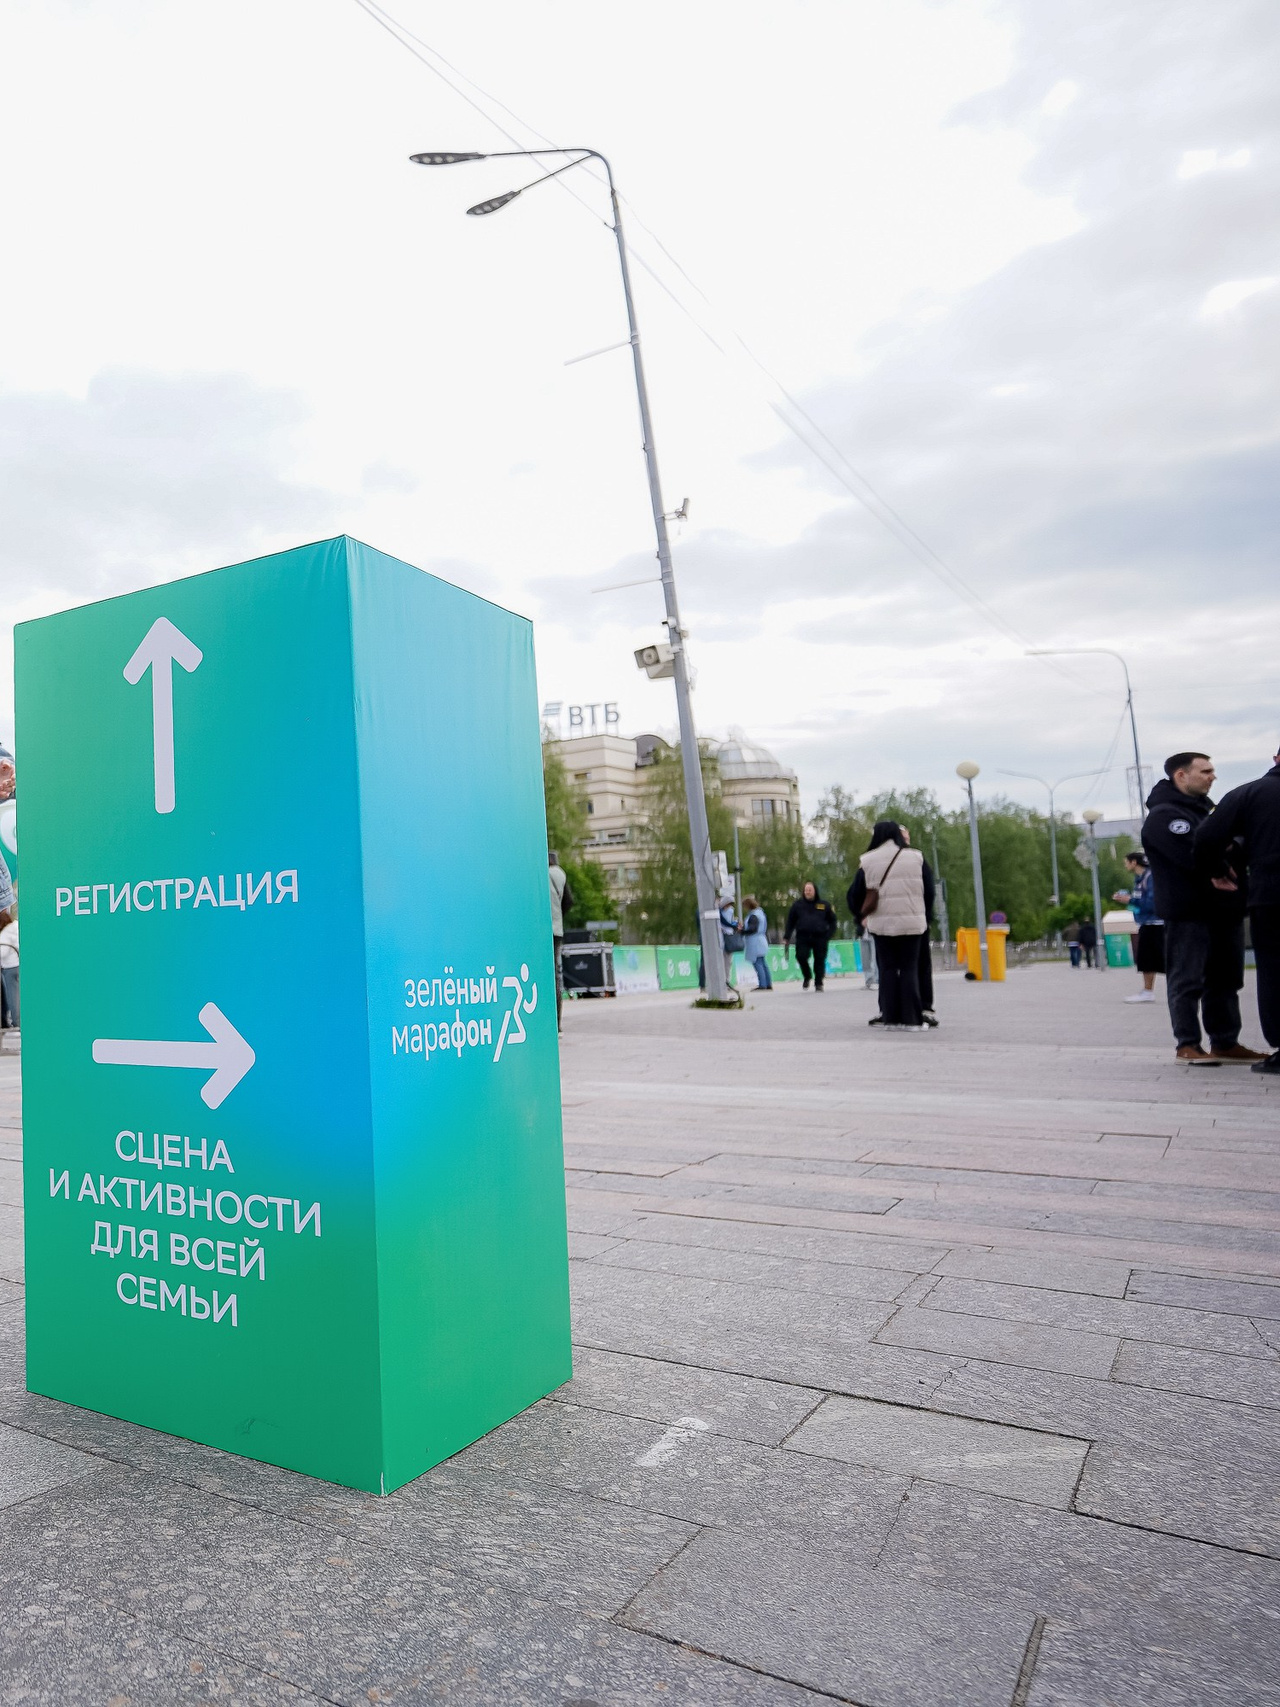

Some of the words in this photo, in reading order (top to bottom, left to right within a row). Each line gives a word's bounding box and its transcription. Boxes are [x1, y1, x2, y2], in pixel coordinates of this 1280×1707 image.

[568, 702, 620, 726] ВТБ
[55, 869, 299, 916] РЕГИСТРАЦИЯ
[404, 965, 498, 1008] зелёный
[392, 1009, 492, 1061] марафон
[115, 1130, 235, 1173] СЦЕНА
[49, 1168, 70, 1200] И
[77, 1172, 322, 1237] АКТИВНОСТИ
[90, 1220, 159, 1262] ДЛЯ
[169, 1232, 266, 1281] ВСЕЙ
[116, 1272, 239, 1327] СЕМЬИ
